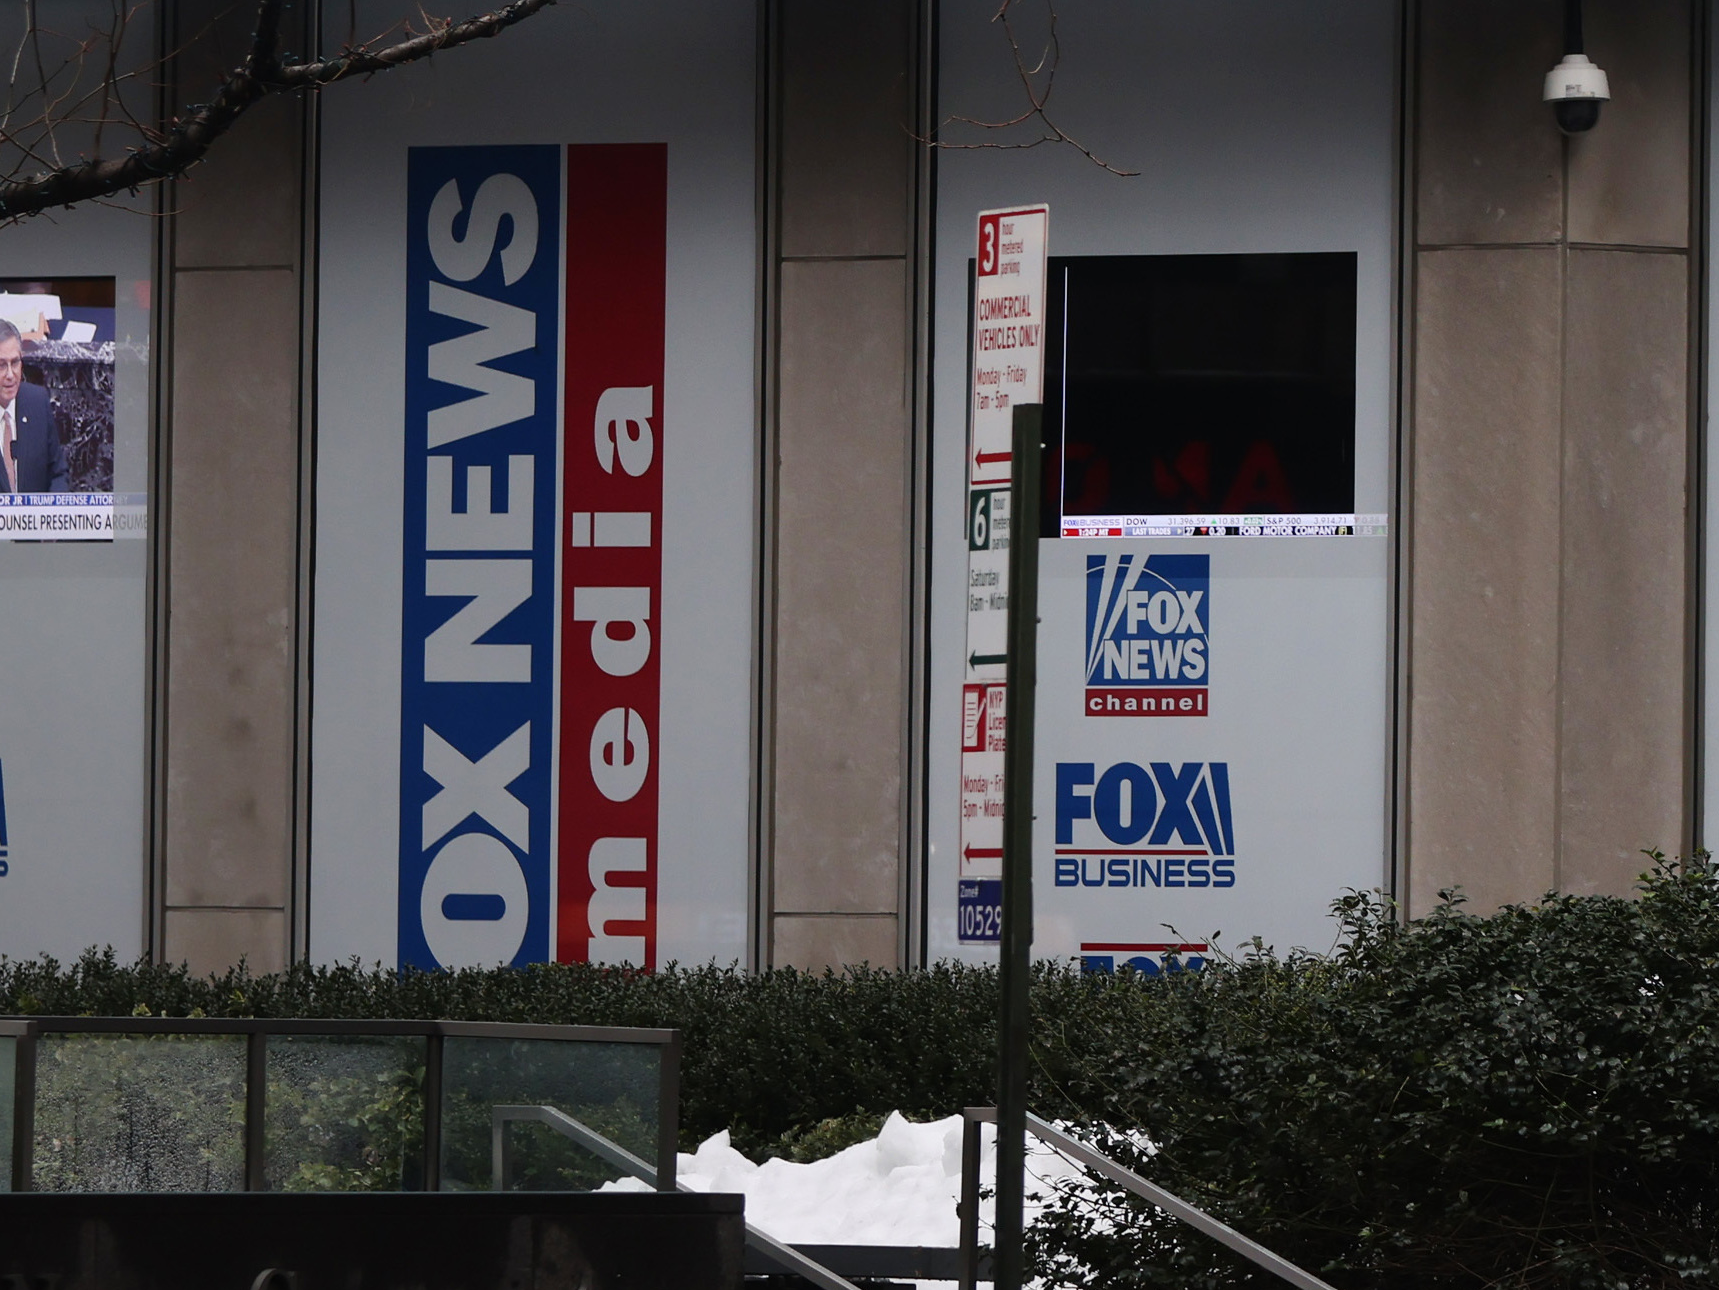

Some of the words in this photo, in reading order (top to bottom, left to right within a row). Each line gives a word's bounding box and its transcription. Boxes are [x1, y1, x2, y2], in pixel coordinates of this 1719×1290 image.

[982, 222, 995, 272] 3
[979, 295, 1031, 321] COMMERCIAL
[979, 326, 1016, 352] VEHICLES
[1019, 323, 1040, 348] ONLY
[977, 367, 1001, 388] Monday
[1007, 365, 1027, 386] Friday
[977, 392, 989, 410] 7am
[995, 391, 1009, 411] 5pm
[424, 172, 540, 683] NEWS
[13, 495, 23, 505] JR
[30, 495, 55, 505] TRUMP
[56, 495, 87, 505] DEFENSE
[41, 514, 101, 530] PRESENTING
[974, 496, 986, 547] 6
[1126, 518, 1147, 526] DOW
[1266, 517, 1282, 525] S&P
[1286, 517, 1301, 525] 500
[1239, 527, 1261, 535] FORD
[1262, 527, 1293, 535] MOTOR
[1295, 526, 1337, 535] COMPANY
[971, 569, 999, 591] Saturday
[1127, 590, 1204, 634] FOX
[1104, 639, 1205, 680] NEWS
[572, 385, 654, 965] media
[1089, 694, 1203, 711] channel
[964, 775, 988, 795] Monday
[963, 799, 977, 820] 5pm
[1055, 762, 1205, 845] FOX
[420, 721, 531, 971] OX
[1055, 859, 1235, 887] BUSINESS
